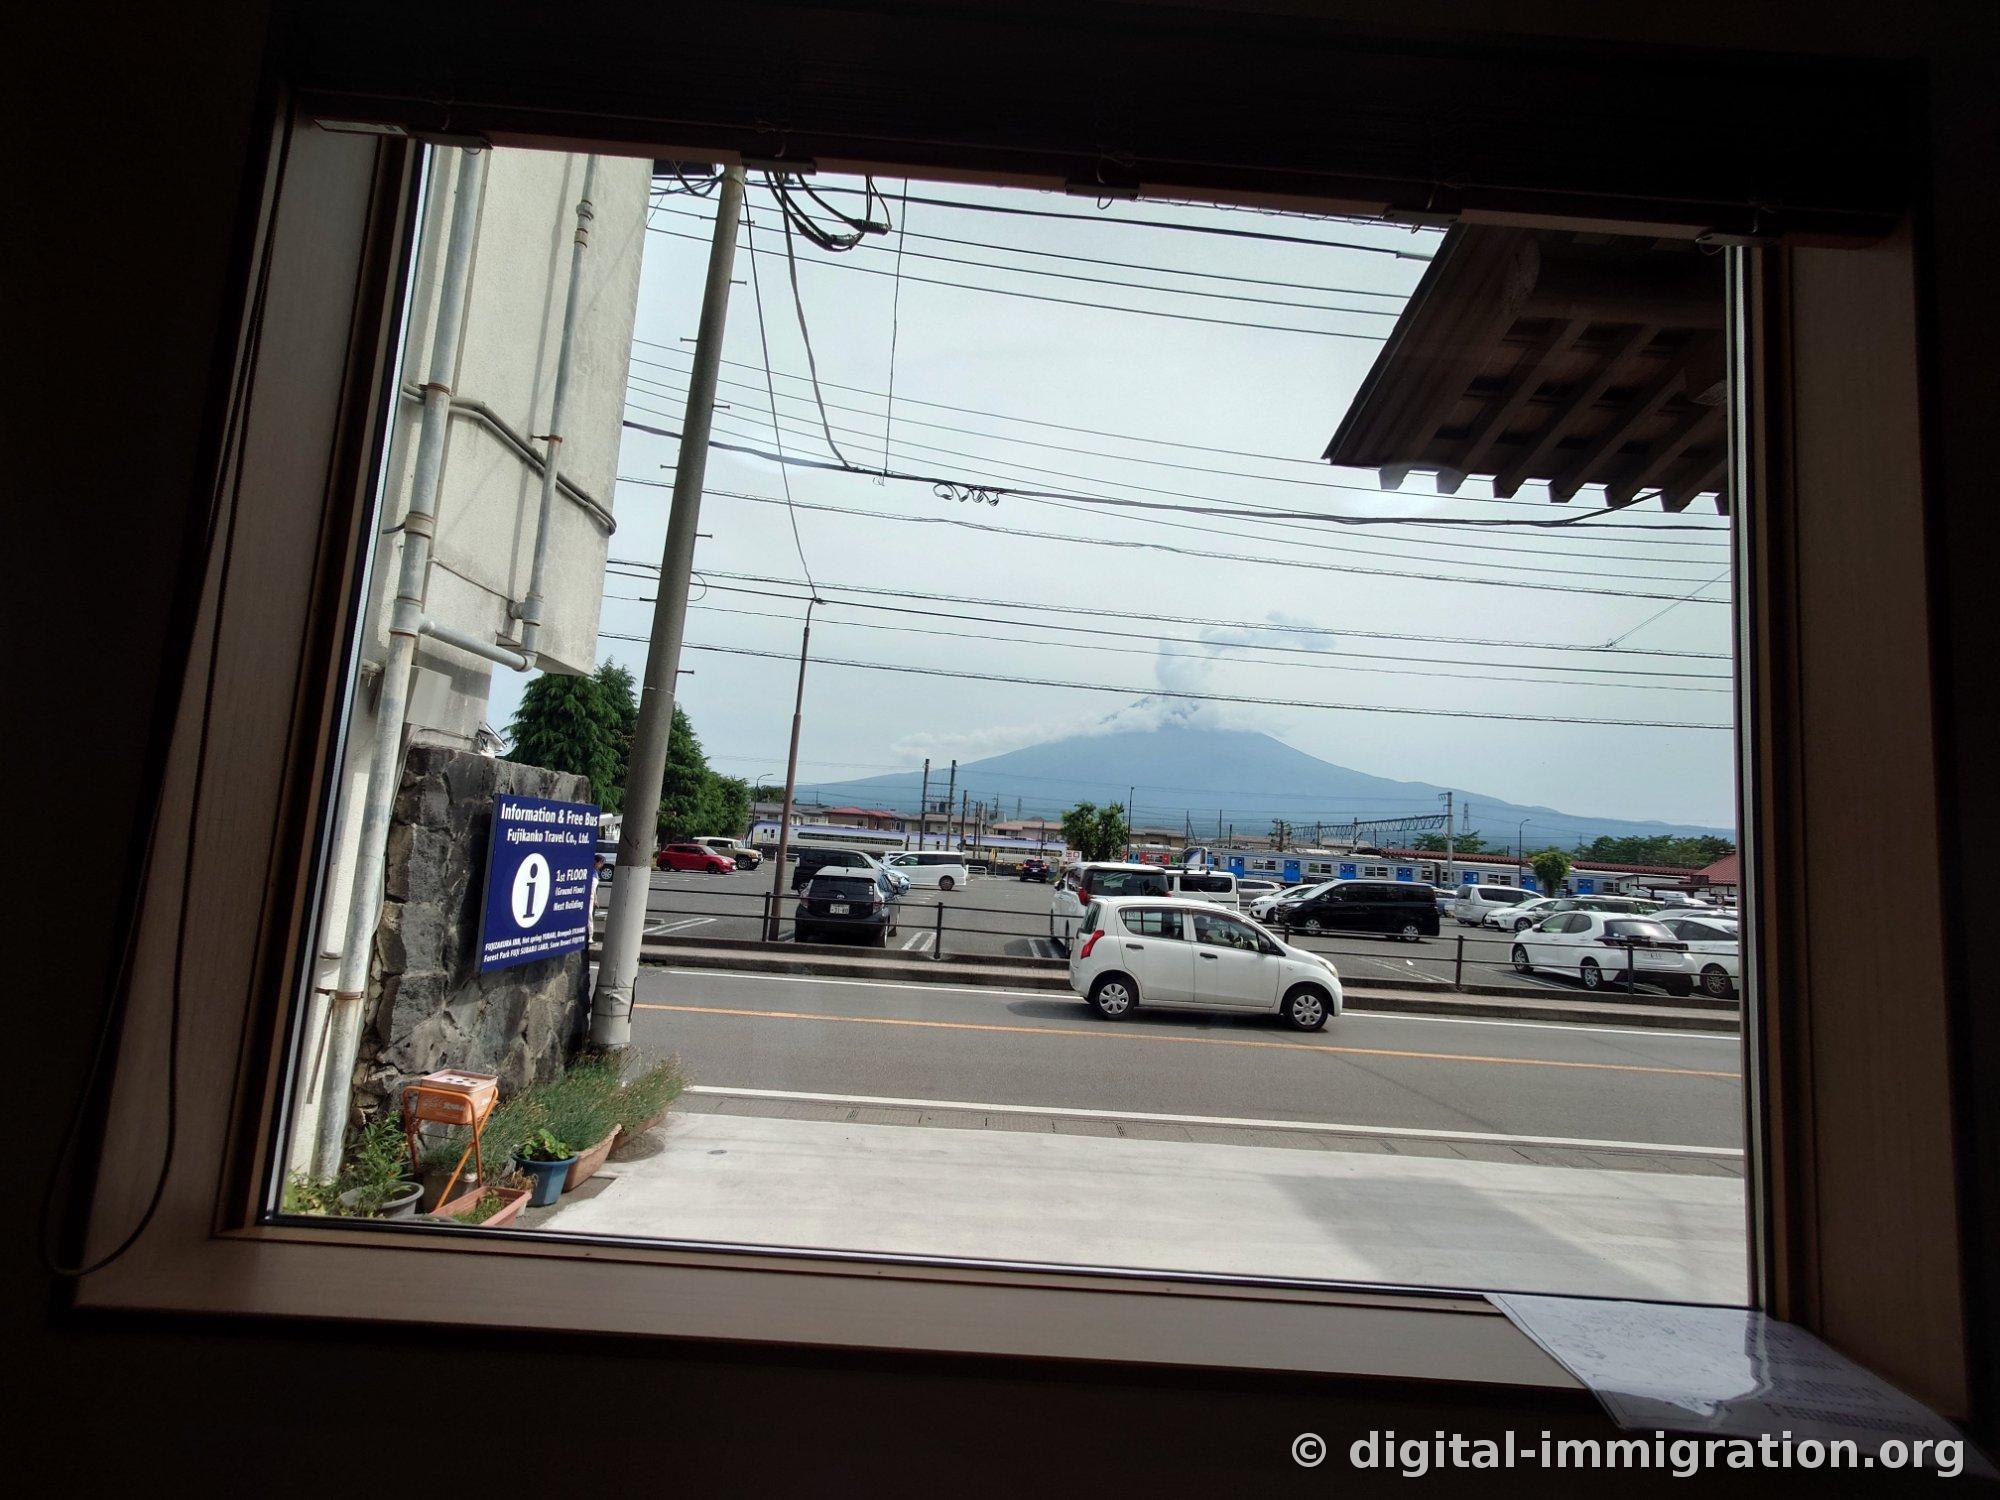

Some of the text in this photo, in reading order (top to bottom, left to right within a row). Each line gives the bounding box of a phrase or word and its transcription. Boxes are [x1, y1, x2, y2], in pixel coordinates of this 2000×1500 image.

[501, 803, 598, 827] Information & Free Bus
[507, 828, 543, 845] Fujikanko
[545, 830, 565, 843] Travel
[578, 832, 590, 844] Ltd.
[556, 868, 588, 882] 1st FLOOR
[484, 952, 498, 962] Forest
[500, 950, 510, 959] Park
